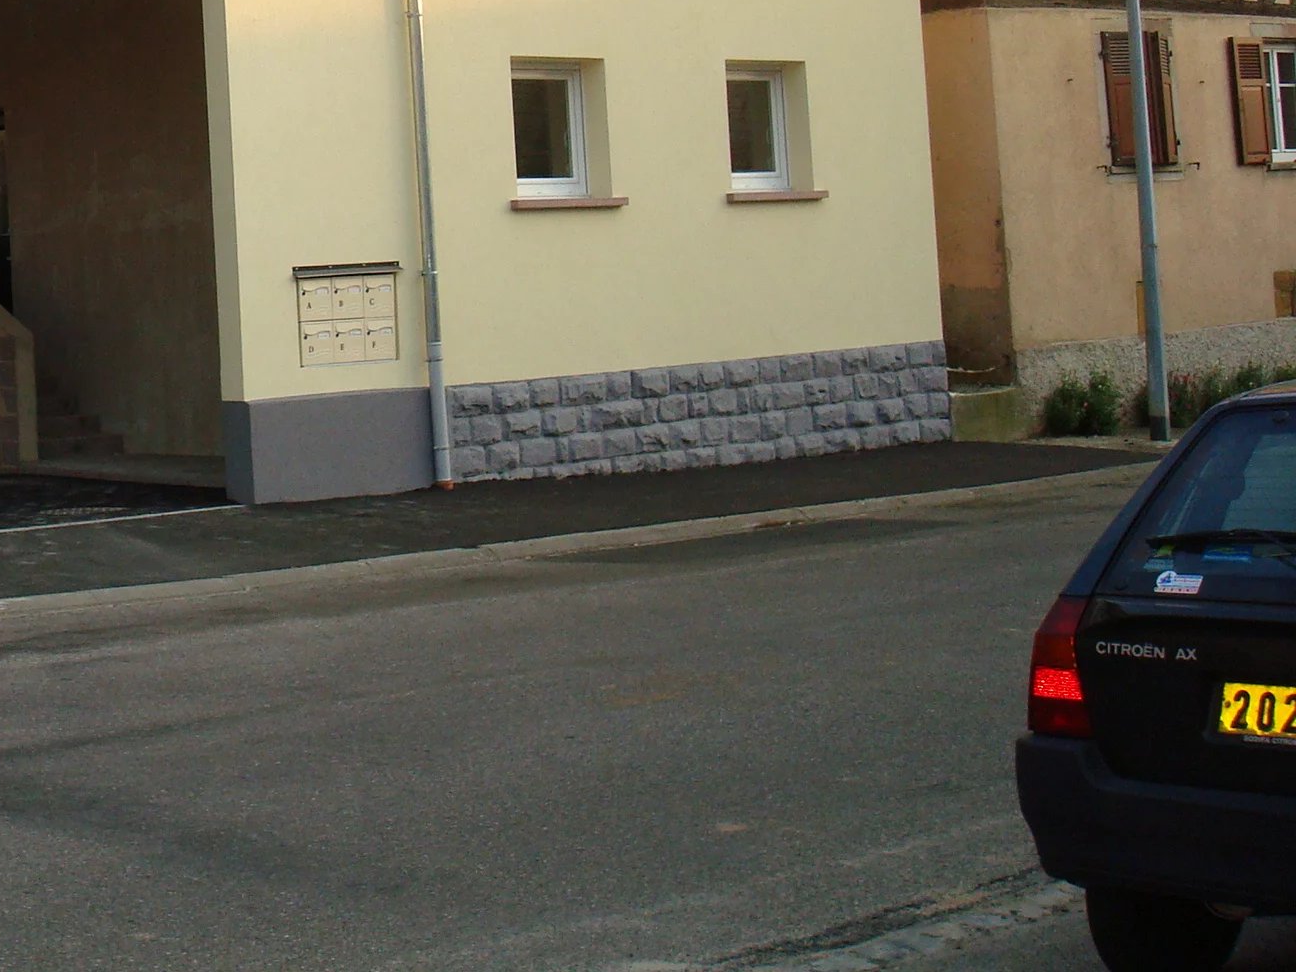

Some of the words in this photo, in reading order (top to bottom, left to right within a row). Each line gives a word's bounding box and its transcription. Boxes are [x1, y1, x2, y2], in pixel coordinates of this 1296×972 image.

[1095, 641, 1165, 659] CITROËN
[1175, 648, 1197, 661] AX
[1230, 689, 1296, 733] 202
